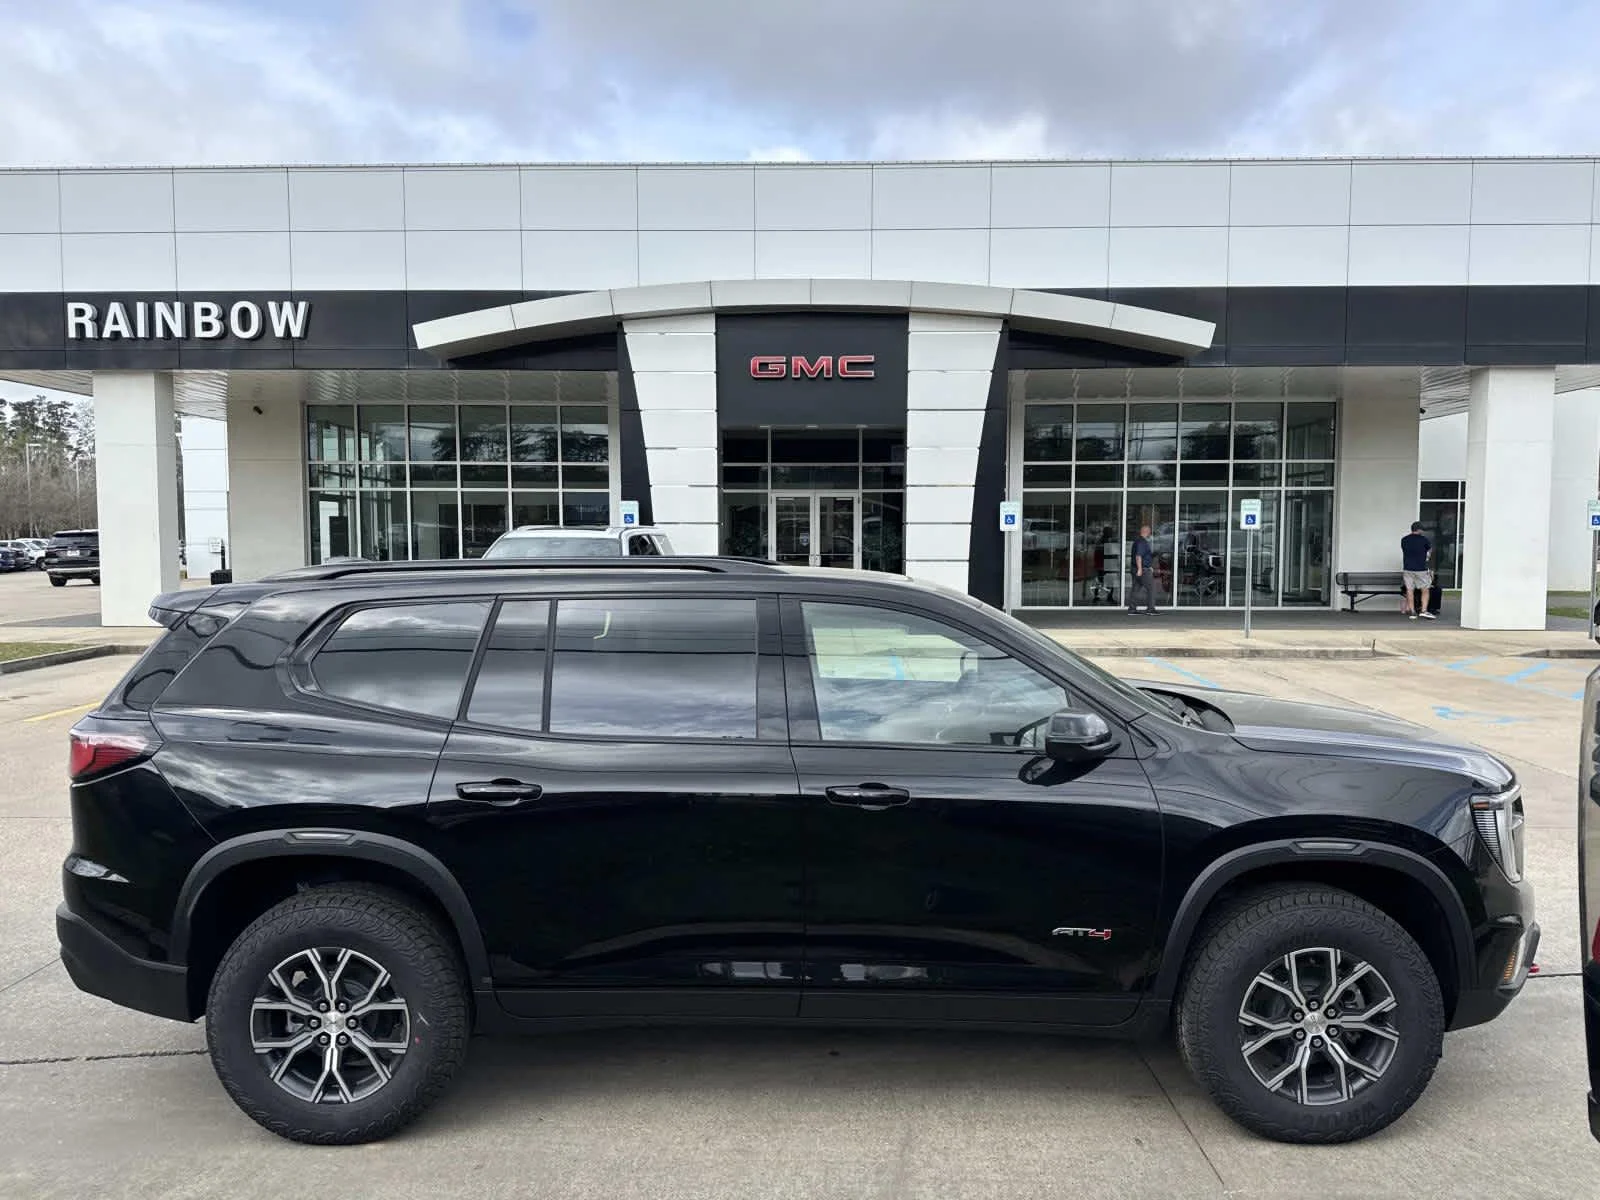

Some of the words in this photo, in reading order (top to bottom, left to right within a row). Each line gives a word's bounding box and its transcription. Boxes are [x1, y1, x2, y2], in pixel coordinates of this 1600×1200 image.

[66, 301, 309, 339] RAINBOW
[751, 355, 875, 379] GMC
[1052, 927, 1112, 941] AT4
